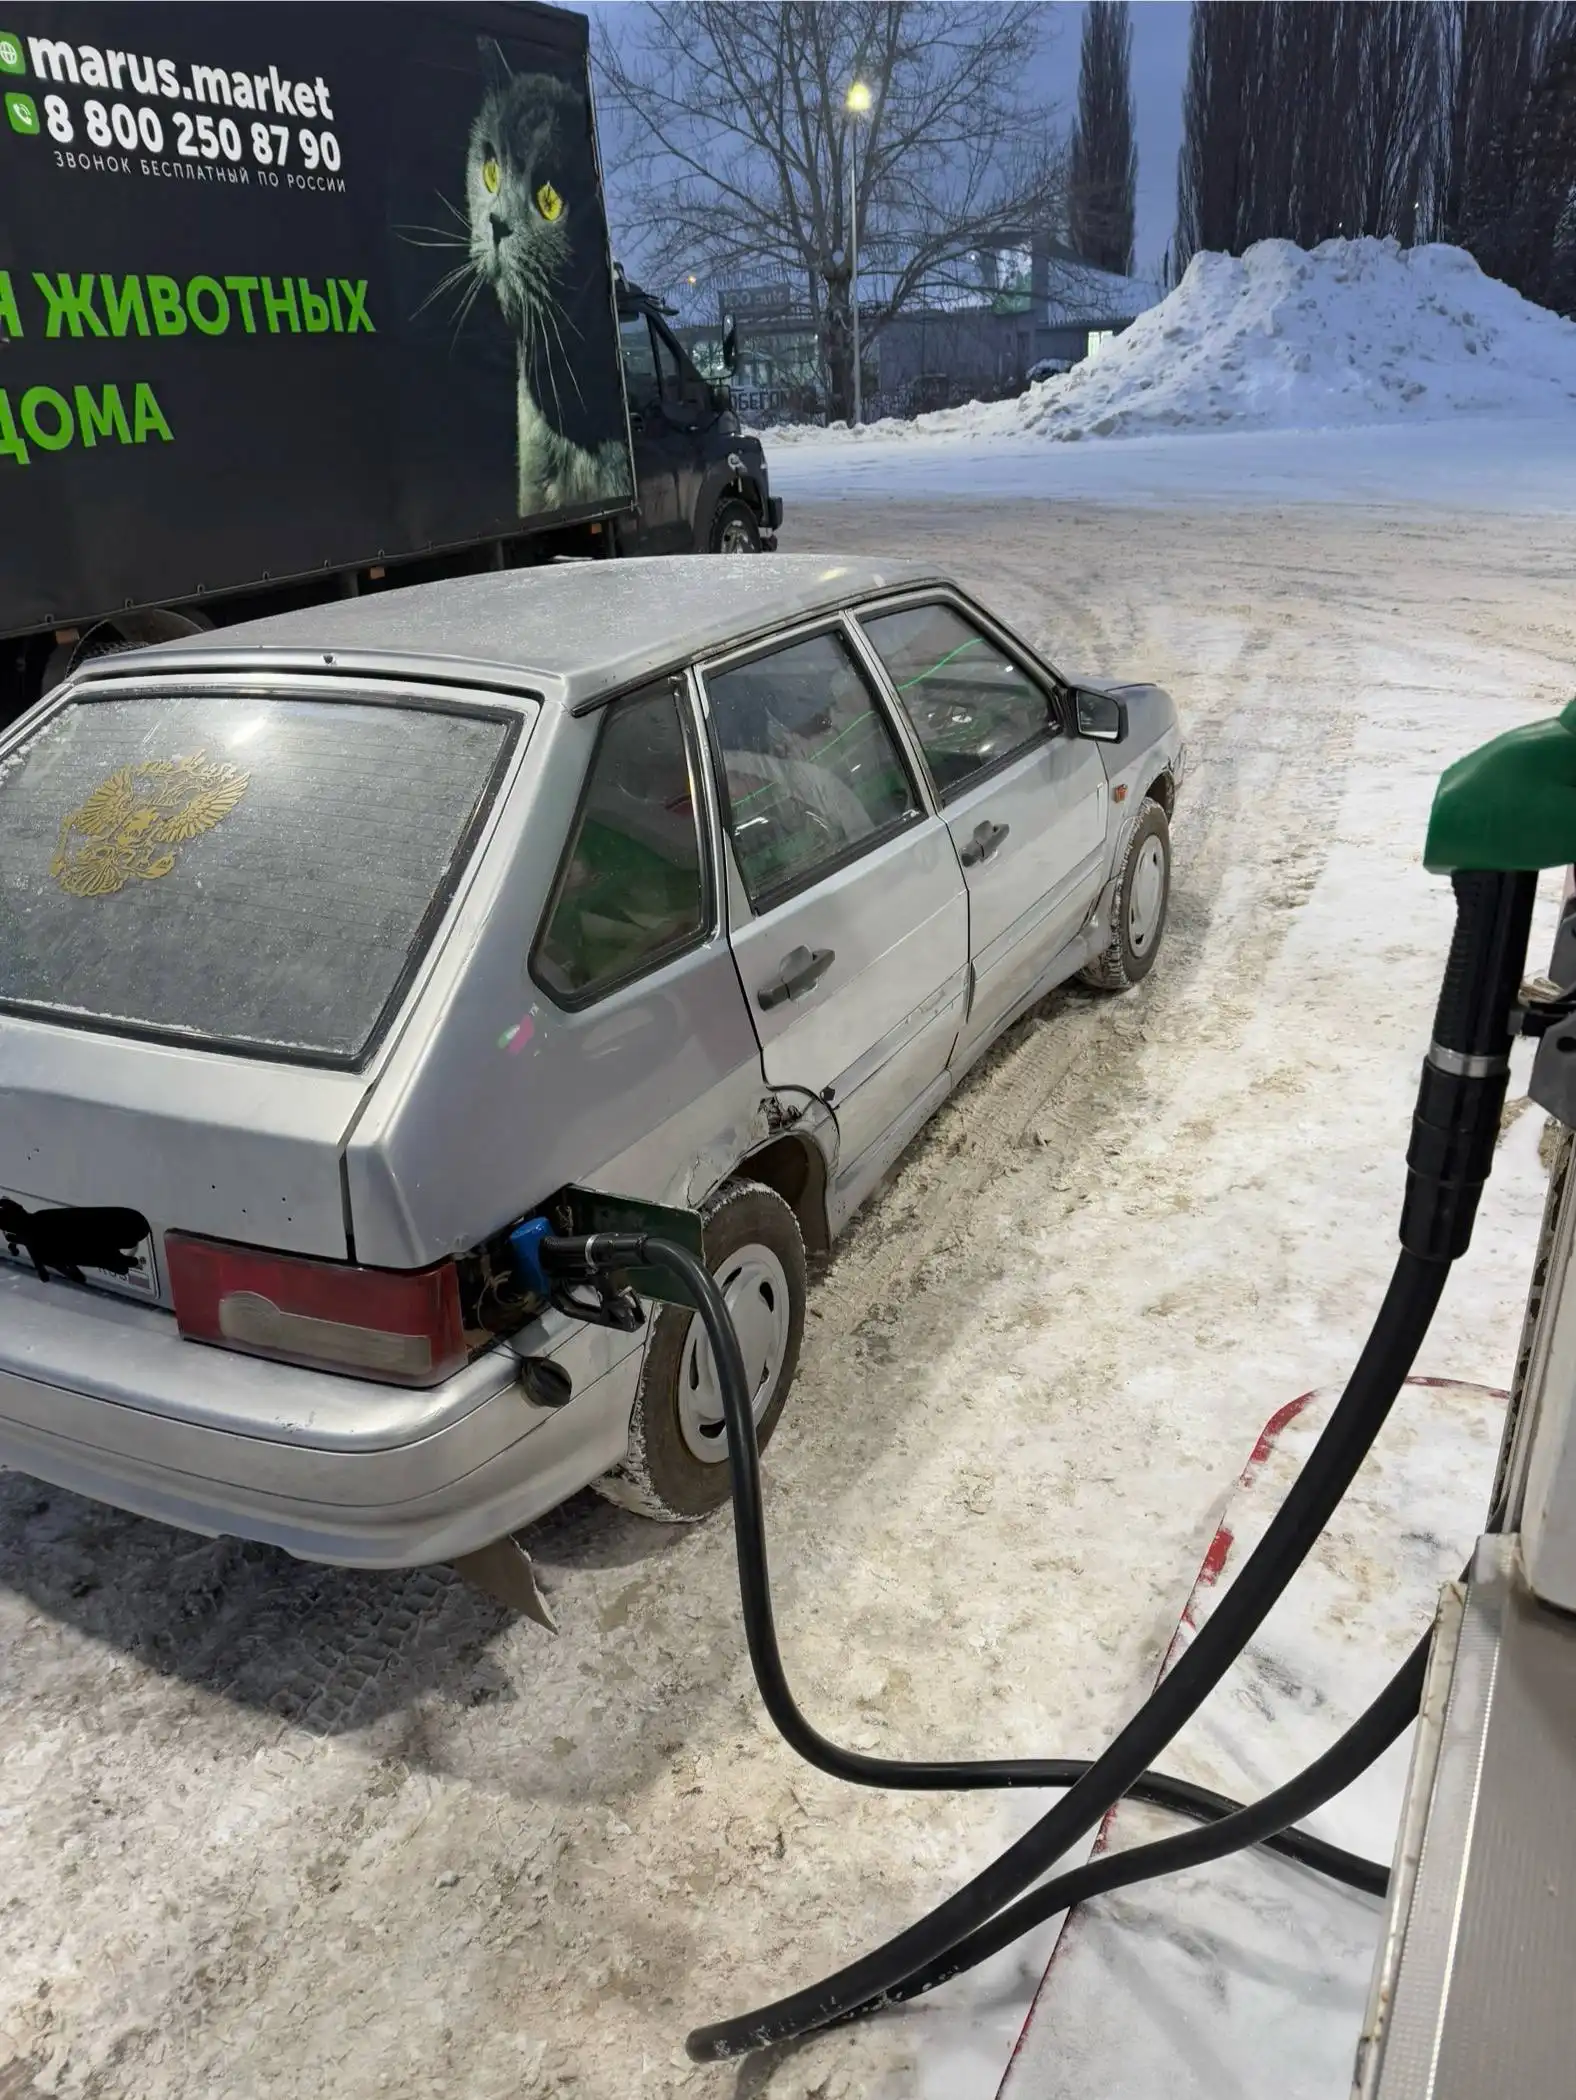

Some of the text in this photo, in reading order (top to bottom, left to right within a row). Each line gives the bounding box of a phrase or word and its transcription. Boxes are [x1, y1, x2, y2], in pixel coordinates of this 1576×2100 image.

[27, 35, 334, 121] marus.market
[44, 94, 341, 172] 8 800 250 87 90
[54, 150, 346, 193] ЗВОНОК БЕСПЛАТНЫЙ ПО РОССИИ
[32, 271, 377, 337] ЖИВОТНЫХ
